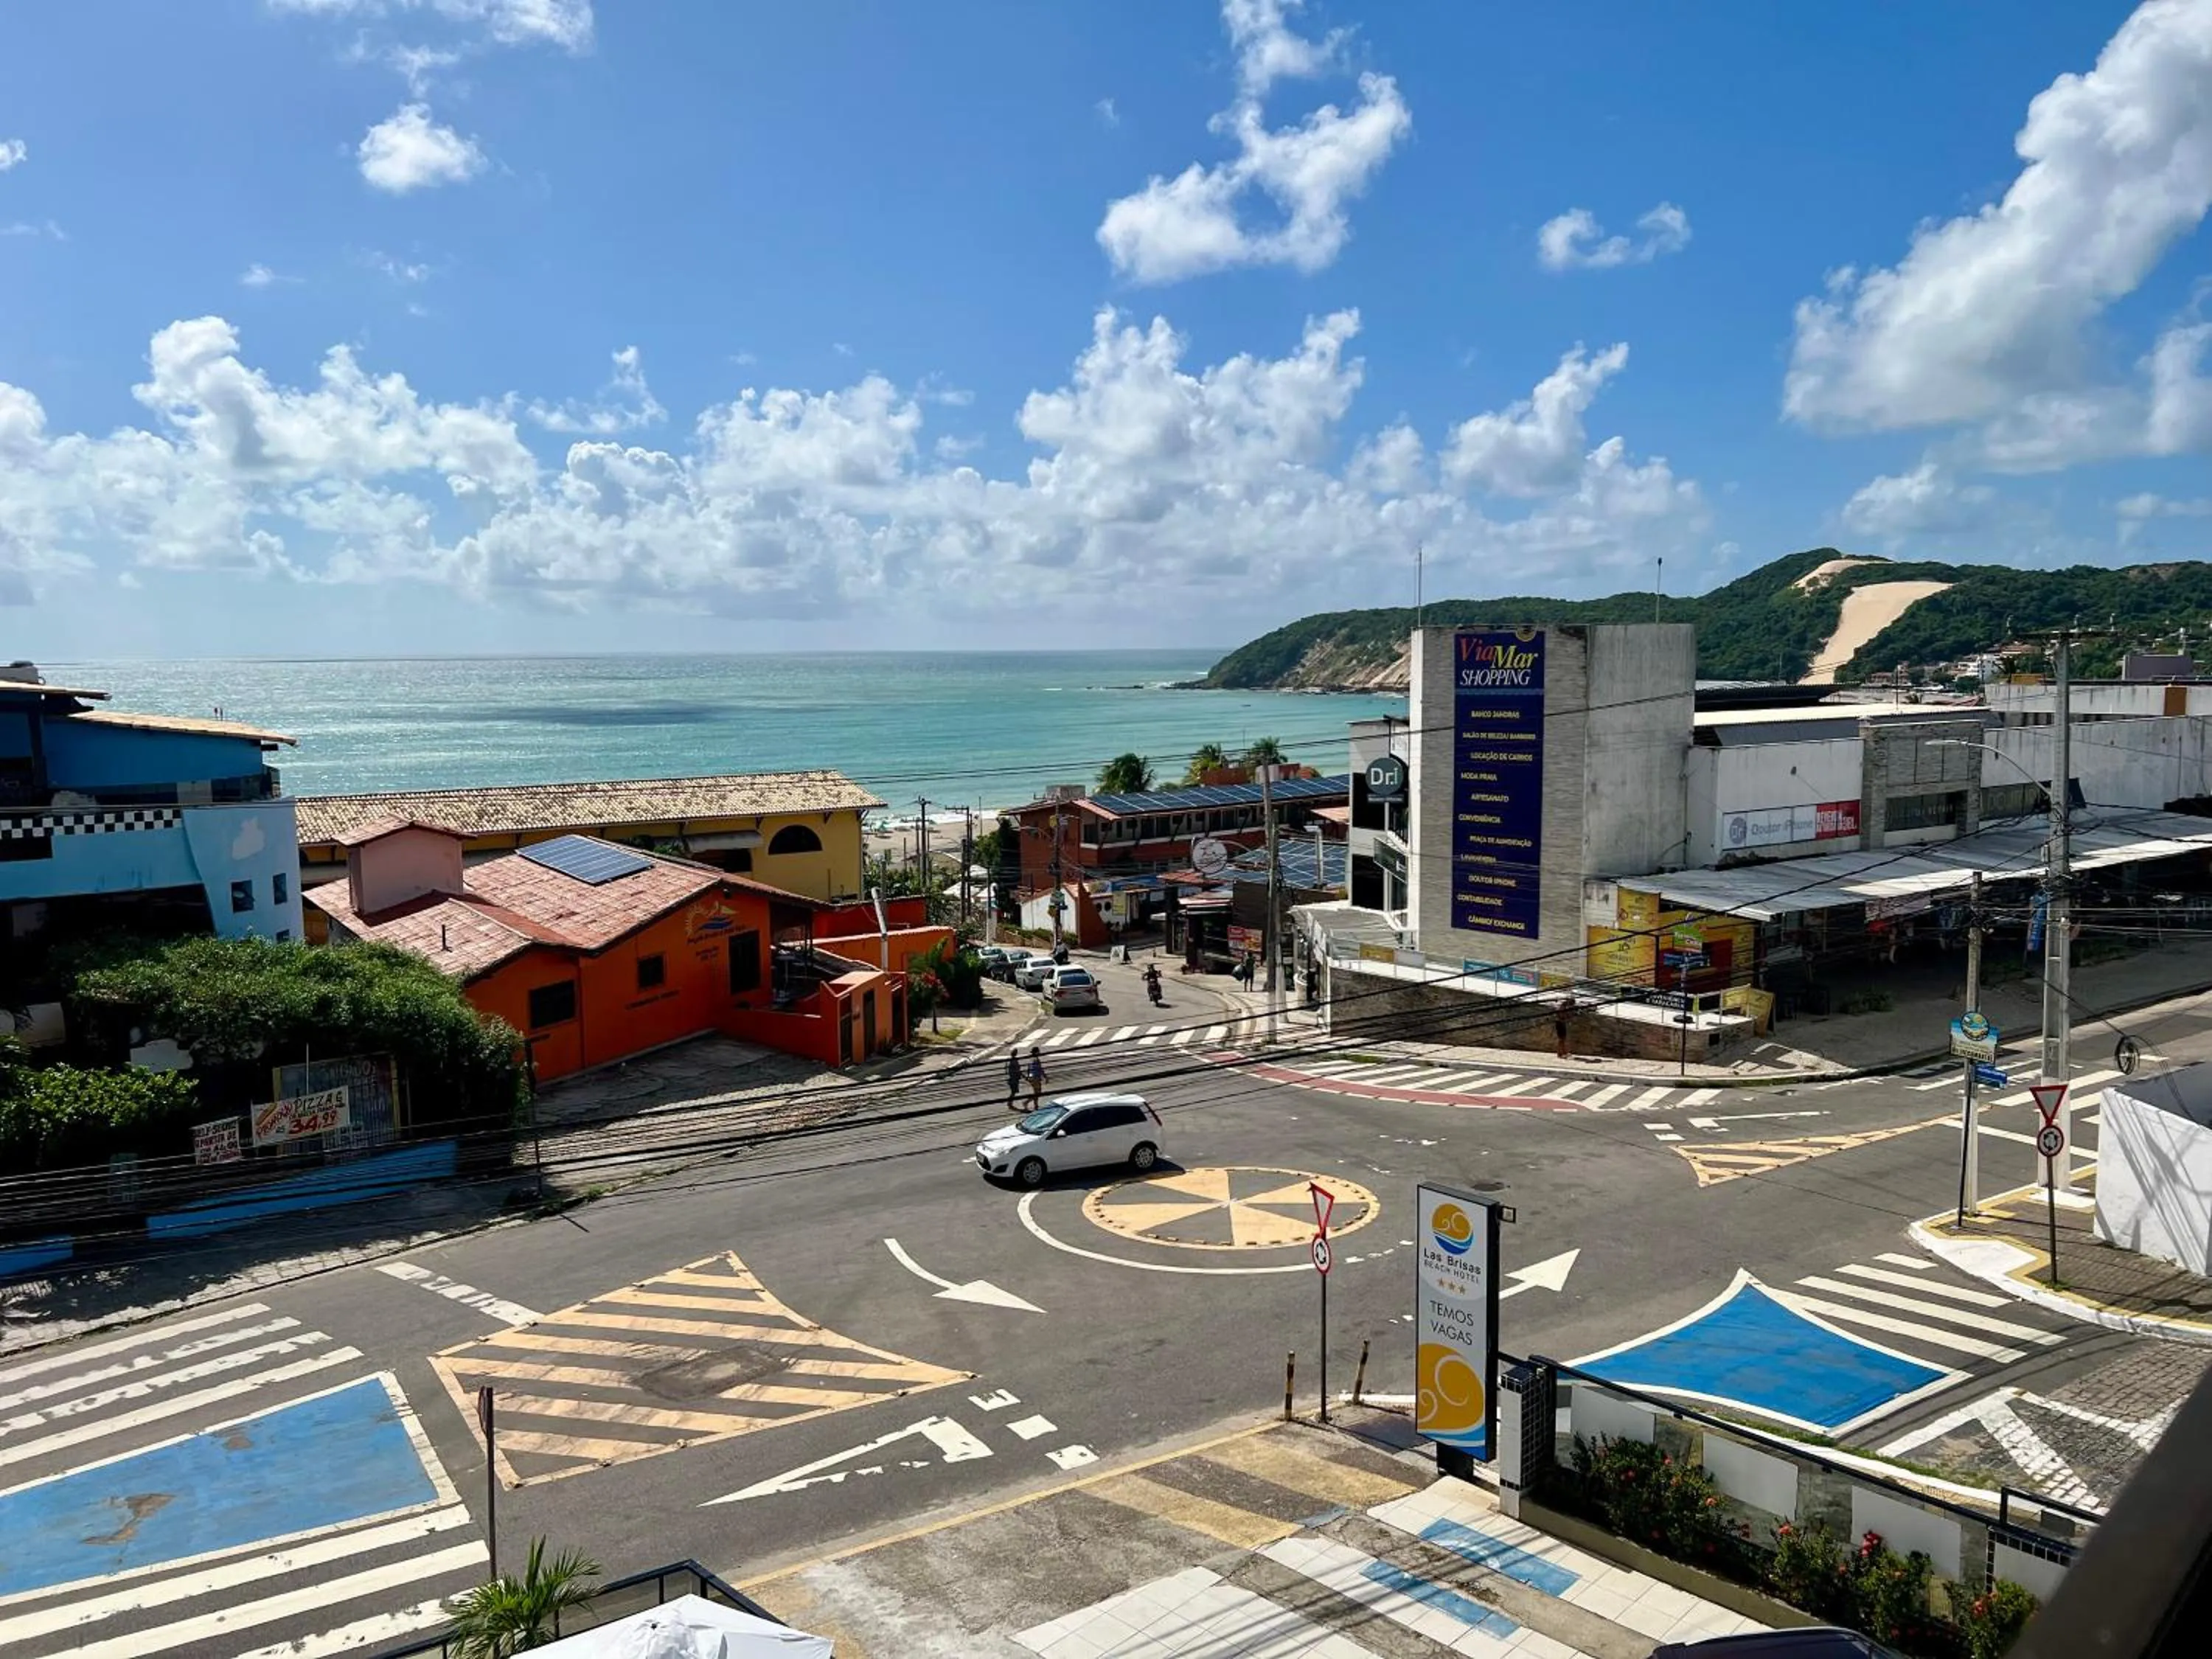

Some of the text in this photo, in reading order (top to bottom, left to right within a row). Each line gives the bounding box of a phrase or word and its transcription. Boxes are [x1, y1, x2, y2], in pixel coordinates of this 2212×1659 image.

[1460, 669, 1531, 686] SHOPPING
[1470, 751, 1498, 761] LOCAÇÃO
[1461, 772, 1478, 780] MODA
[1470, 793, 1509, 803] ARTESANATO
[1457, 894, 1503, 906] CONTABILIDADE
[1424, 1248, 1481, 1275] Las Brisas
[1424, 1259, 1479, 1284] BEACH HOTEL
[1430, 1300, 1474, 1327] TEMOS
[1430, 1319, 1473, 1346] VAGAS
